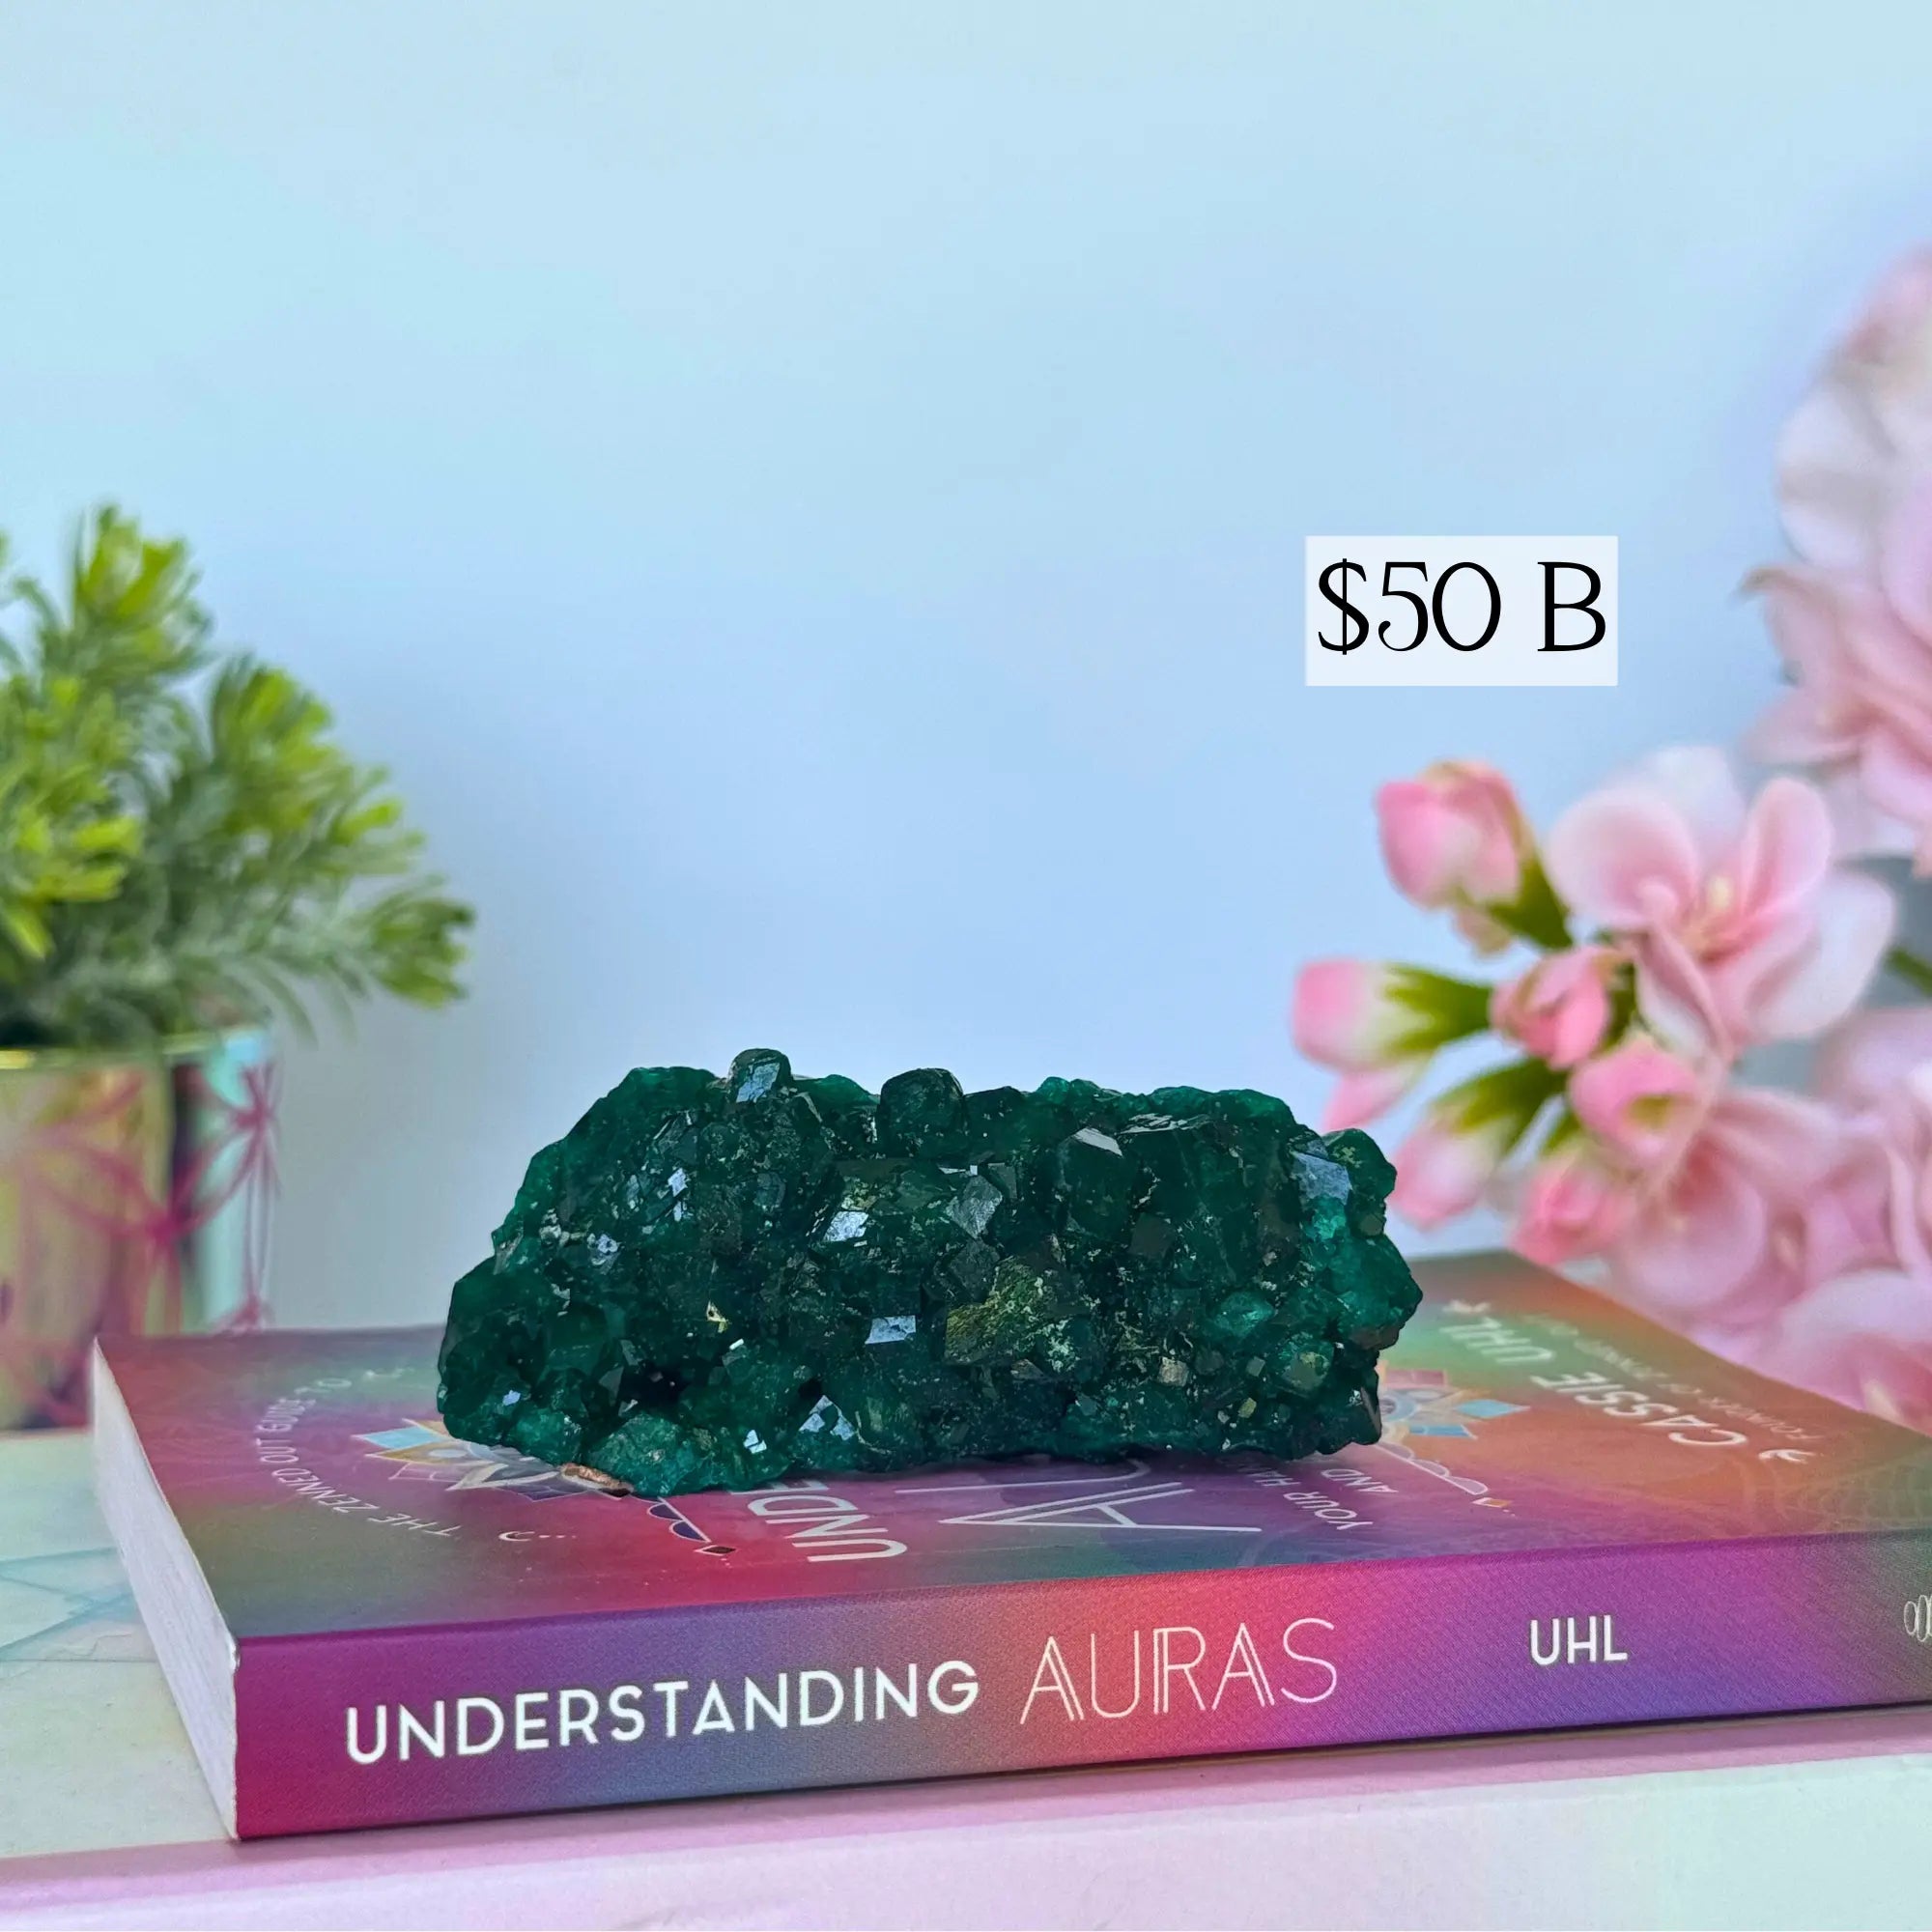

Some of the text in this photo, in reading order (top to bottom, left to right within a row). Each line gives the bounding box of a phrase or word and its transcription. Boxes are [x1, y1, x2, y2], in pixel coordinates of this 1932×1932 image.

[1438, 1317, 1557, 1366] UHL
[1530, 1371, 1749, 1446] CASSIE
[254, 1437, 299, 1463] OUT
[270, 1466, 381, 1514] ZENNED
[1320, 1467, 1400, 1494] AND
[367, 1513, 462, 1537] THE
[1282, 1491, 1375, 1531] YOUR
[345, 1613, 1630, 1766] UNDERSTANDING AURAS UHL
